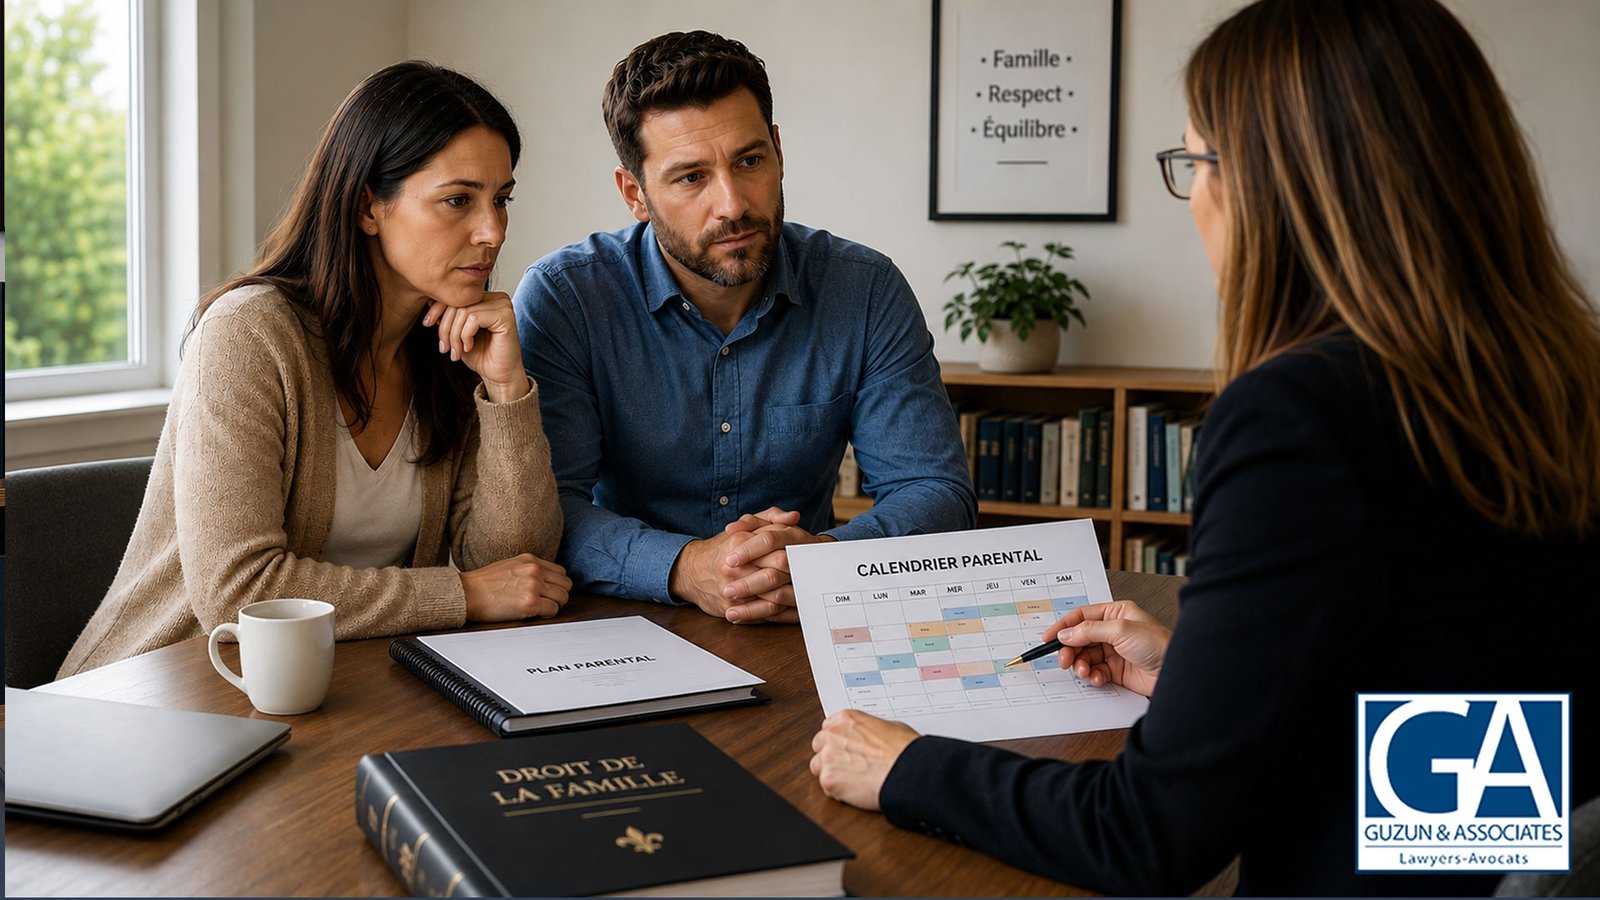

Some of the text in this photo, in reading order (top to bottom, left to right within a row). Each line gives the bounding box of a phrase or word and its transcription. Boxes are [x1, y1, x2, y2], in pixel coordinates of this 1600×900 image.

[993, 48, 1061, 69] Famille
[988, 84, 1063, 108] Respect
[983, 115, 1066, 143] Équilibre
[856, 548, 1044, 577] CALENDRIER PARENTAL
[835, 595, 851, 603] DIM
[872, 592, 889, 600] LUN
[909, 588, 927, 596] MAR
[946, 585, 963, 593] MER
[985, 582, 1000, 590] JEU
[1055, 575, 1073, 583] SAM
[526, 654, 657, 674] PLAN PARENTAL
[496, 756, 645, 784] DROIT DE
[492, 771, 685, 806] LA FAMILLE
